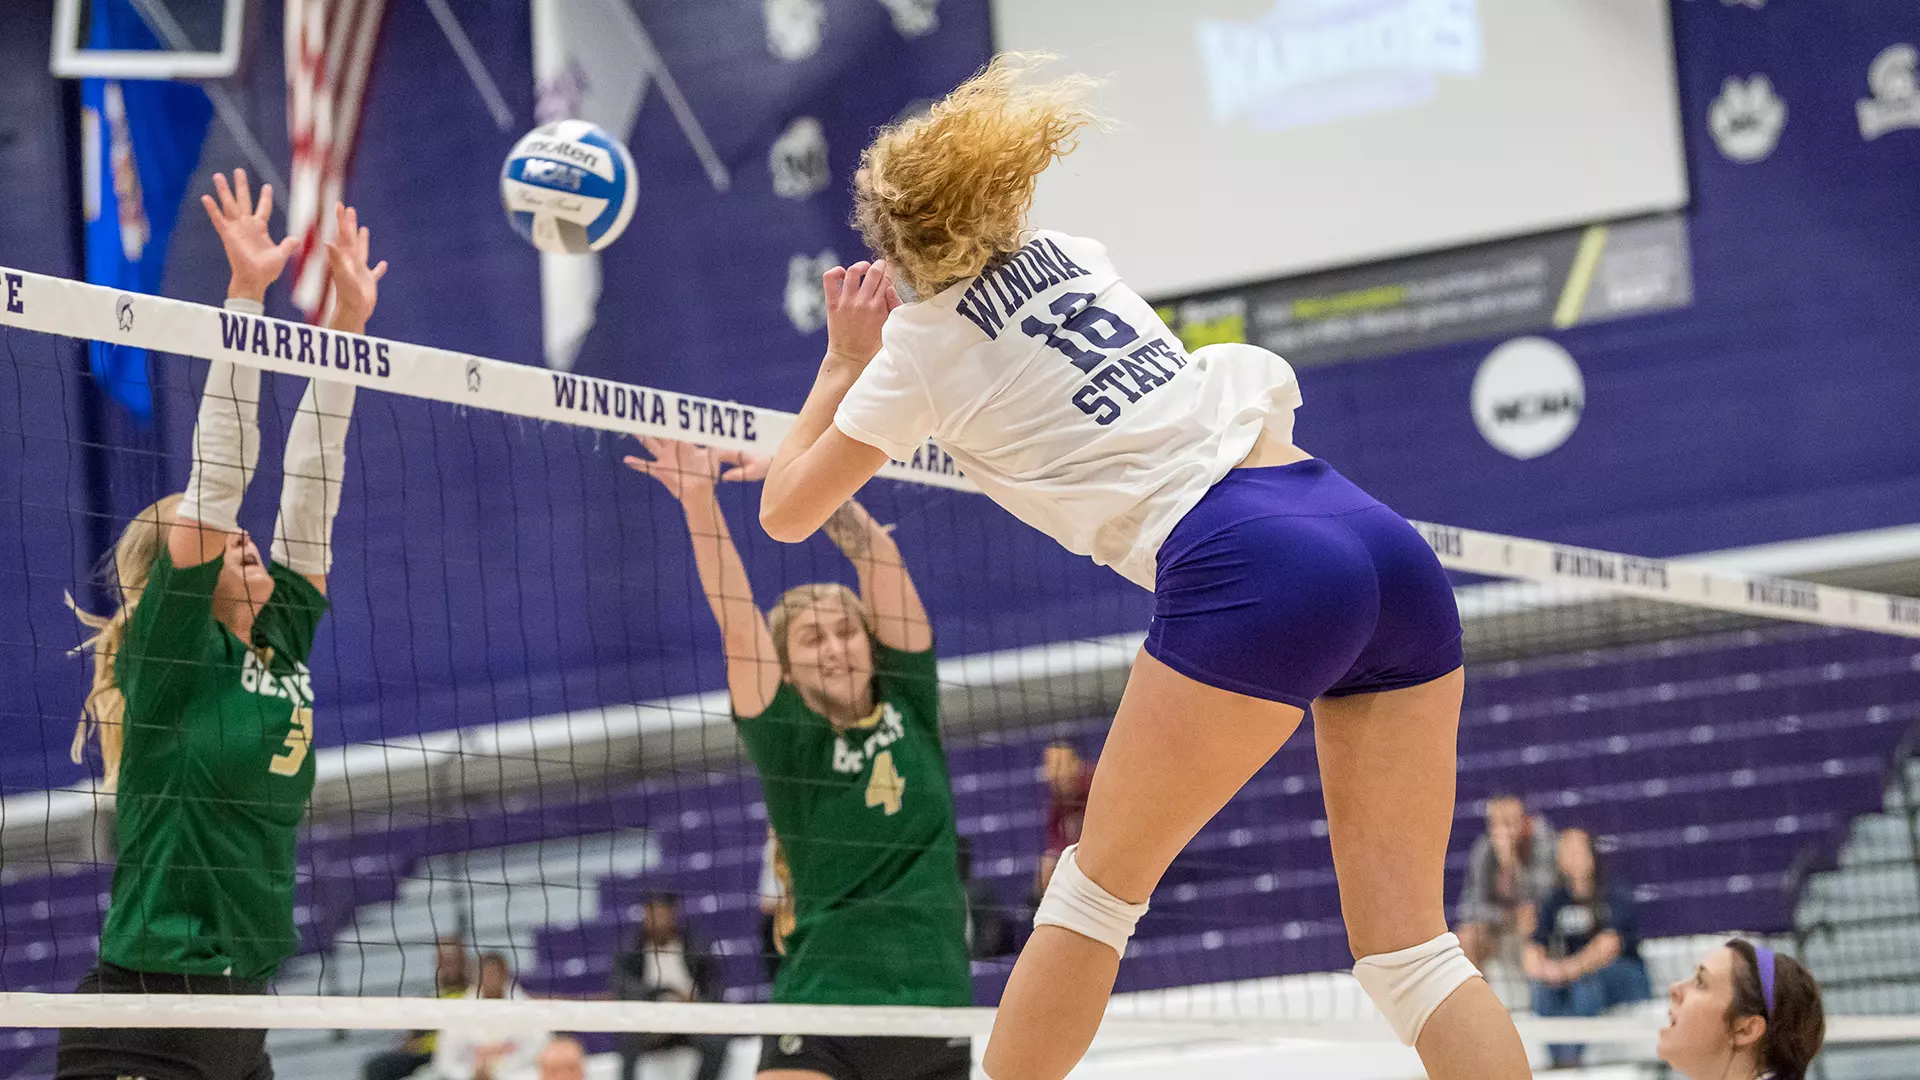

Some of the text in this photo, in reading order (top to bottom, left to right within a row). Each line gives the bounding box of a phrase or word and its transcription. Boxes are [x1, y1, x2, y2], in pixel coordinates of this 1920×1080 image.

[526, 140, 598, 167] molten
[0, 272, 24, 315] E
[955, 237, 1092, 341] WINONA
[220, 312, 391, 378] WARRIORS
[1020, 291, 1140, 375] 16
[552, 374, 757, 442] WINONA STATE
[1072, 338, 1188, 425] STATE
[890, 443, 965, 477] ARR
[268, 705, 314, 777] 3
[865, 750, 906, 816] 4
